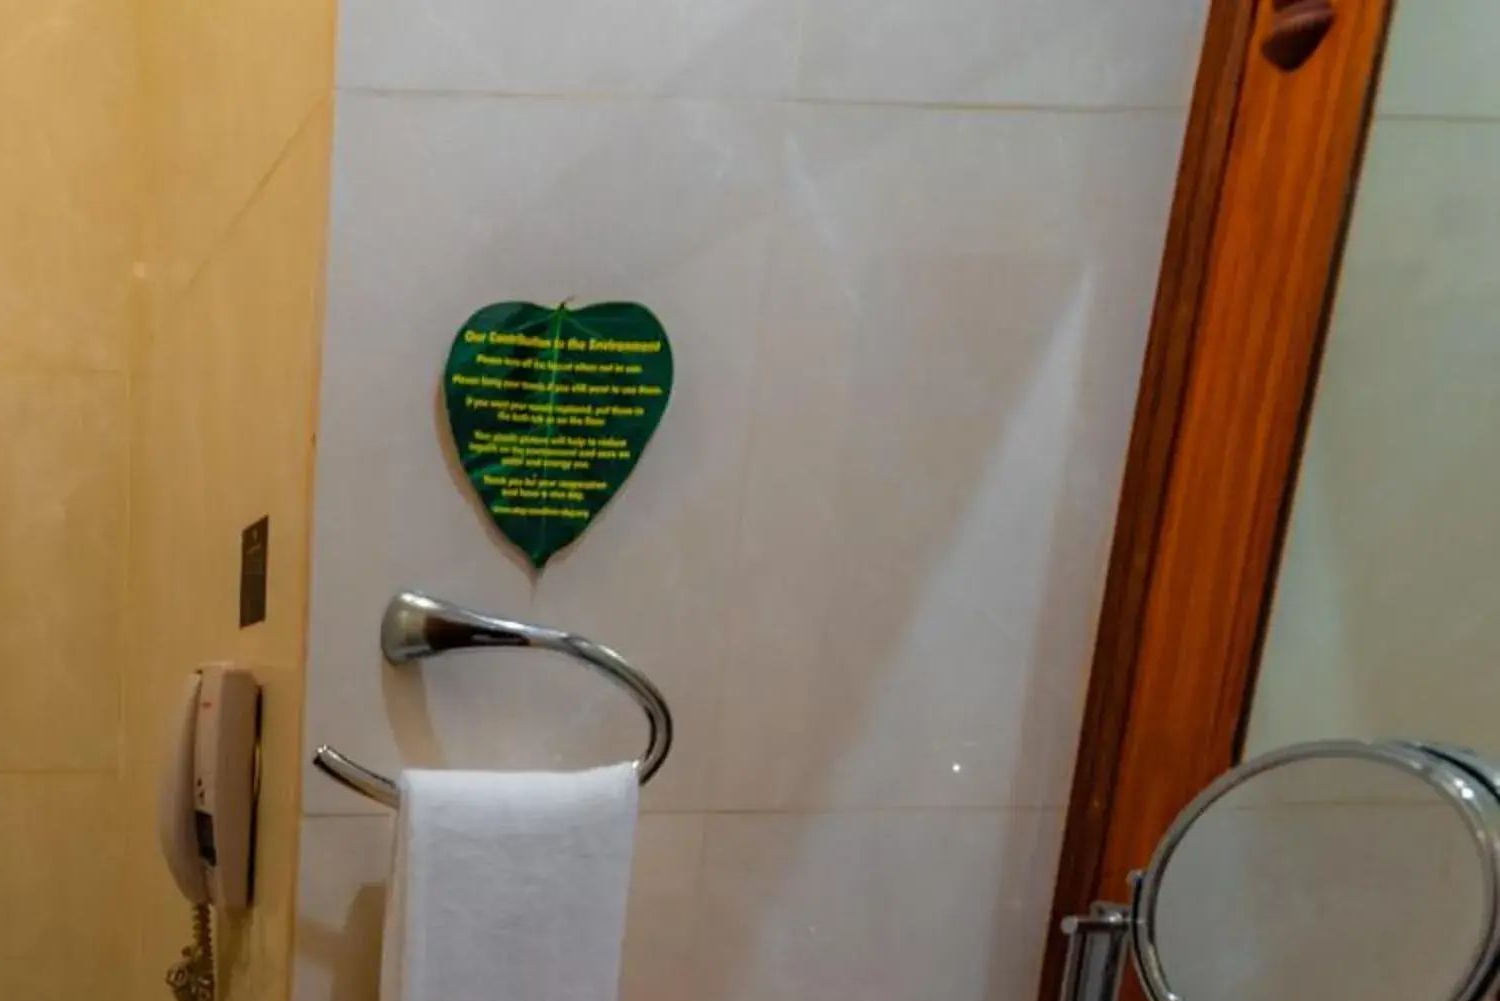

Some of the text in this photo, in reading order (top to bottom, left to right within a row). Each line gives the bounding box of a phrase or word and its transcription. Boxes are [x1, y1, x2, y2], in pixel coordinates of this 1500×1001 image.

[464, 330, 485, 343] Our
[568, 338, 585, 351] the
[589, 338, 660, 352] Environment
[477, 355, 502, 365] Please
[598, 364, 613, 373] not
[452, 374, 480, 385] Please
[474, 399, 488, 410] you
[497, 411, 510, 421] the
[569, 416, 583, 426] the
[508, 478, 523, 487] you
